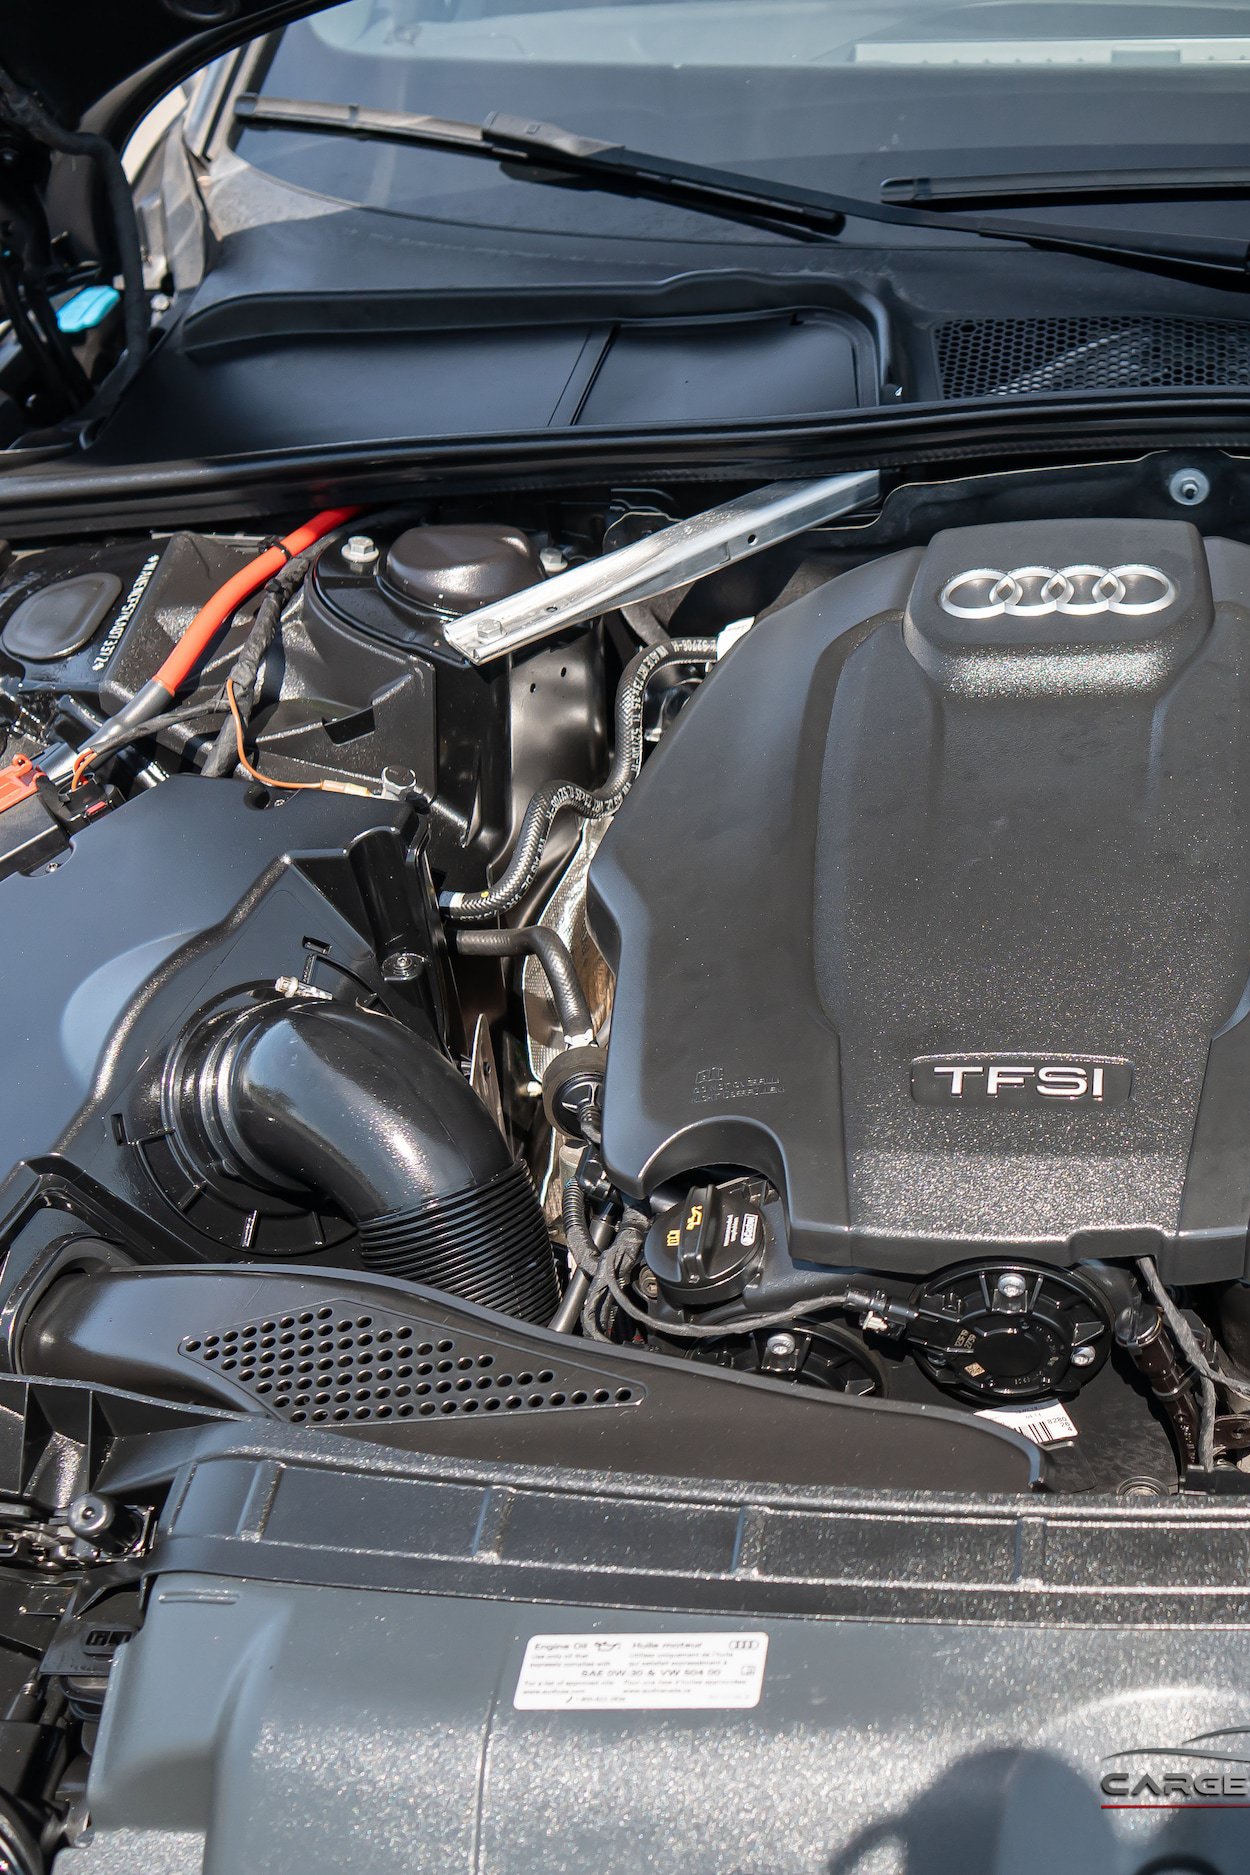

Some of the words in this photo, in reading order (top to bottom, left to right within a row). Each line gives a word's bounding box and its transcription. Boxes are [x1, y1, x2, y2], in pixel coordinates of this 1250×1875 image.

[933, 1066, 1104, 1101] TFSI
[534, 1643, 569, 1651] Engine
[573, 1642, 589, 1650] Oil
